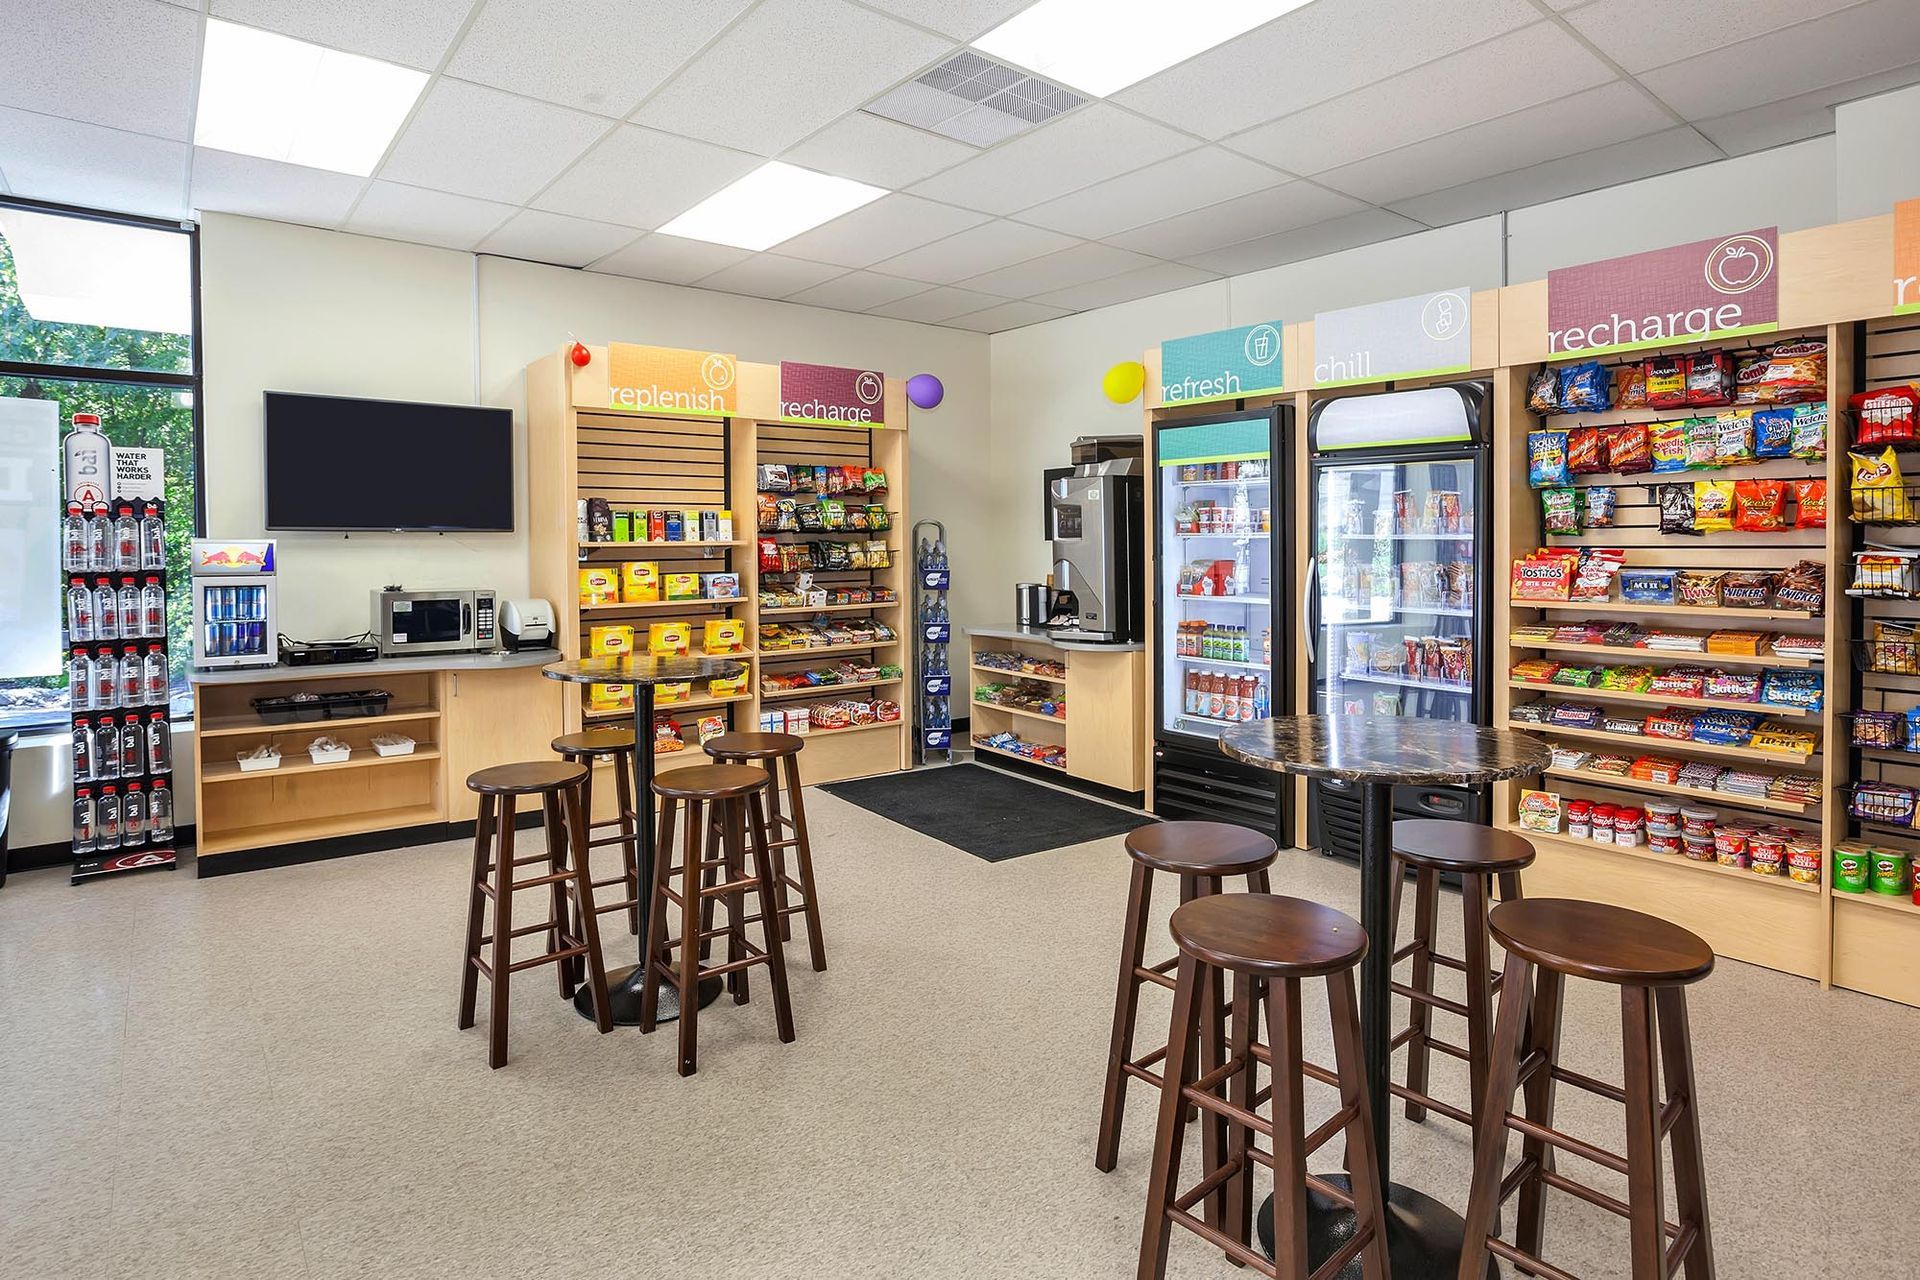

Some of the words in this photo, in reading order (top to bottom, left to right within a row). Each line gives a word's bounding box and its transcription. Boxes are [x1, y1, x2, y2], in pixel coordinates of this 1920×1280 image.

[1893, 275, 1920, 306] r
[1548, 302, 1742, 354] recharge
[1775, 342, 1824, 354] Combos
[1314, 351, 1372, 384] chill
[1738, 364, 1769, 381] Comb
[1161, 371, 1242, 402] refresh
[609, 384, 725, 412] replenish
[780, 399, 872, 426] recharge
[1654, 438, 1685, 452] Swedis
[1663, 447, 1683, 456] Fish
[1681, 586, 1716, 600] TWIX
[1777, 587, 1821, 604] SNICKER
[1652, 680, 1693, 689] Skittles
[1709, 684, 1754, 694] Skittles
[1768, 690, 1817, 704] Skittles
[1556, 709, 1590, 719] CRUNCH
